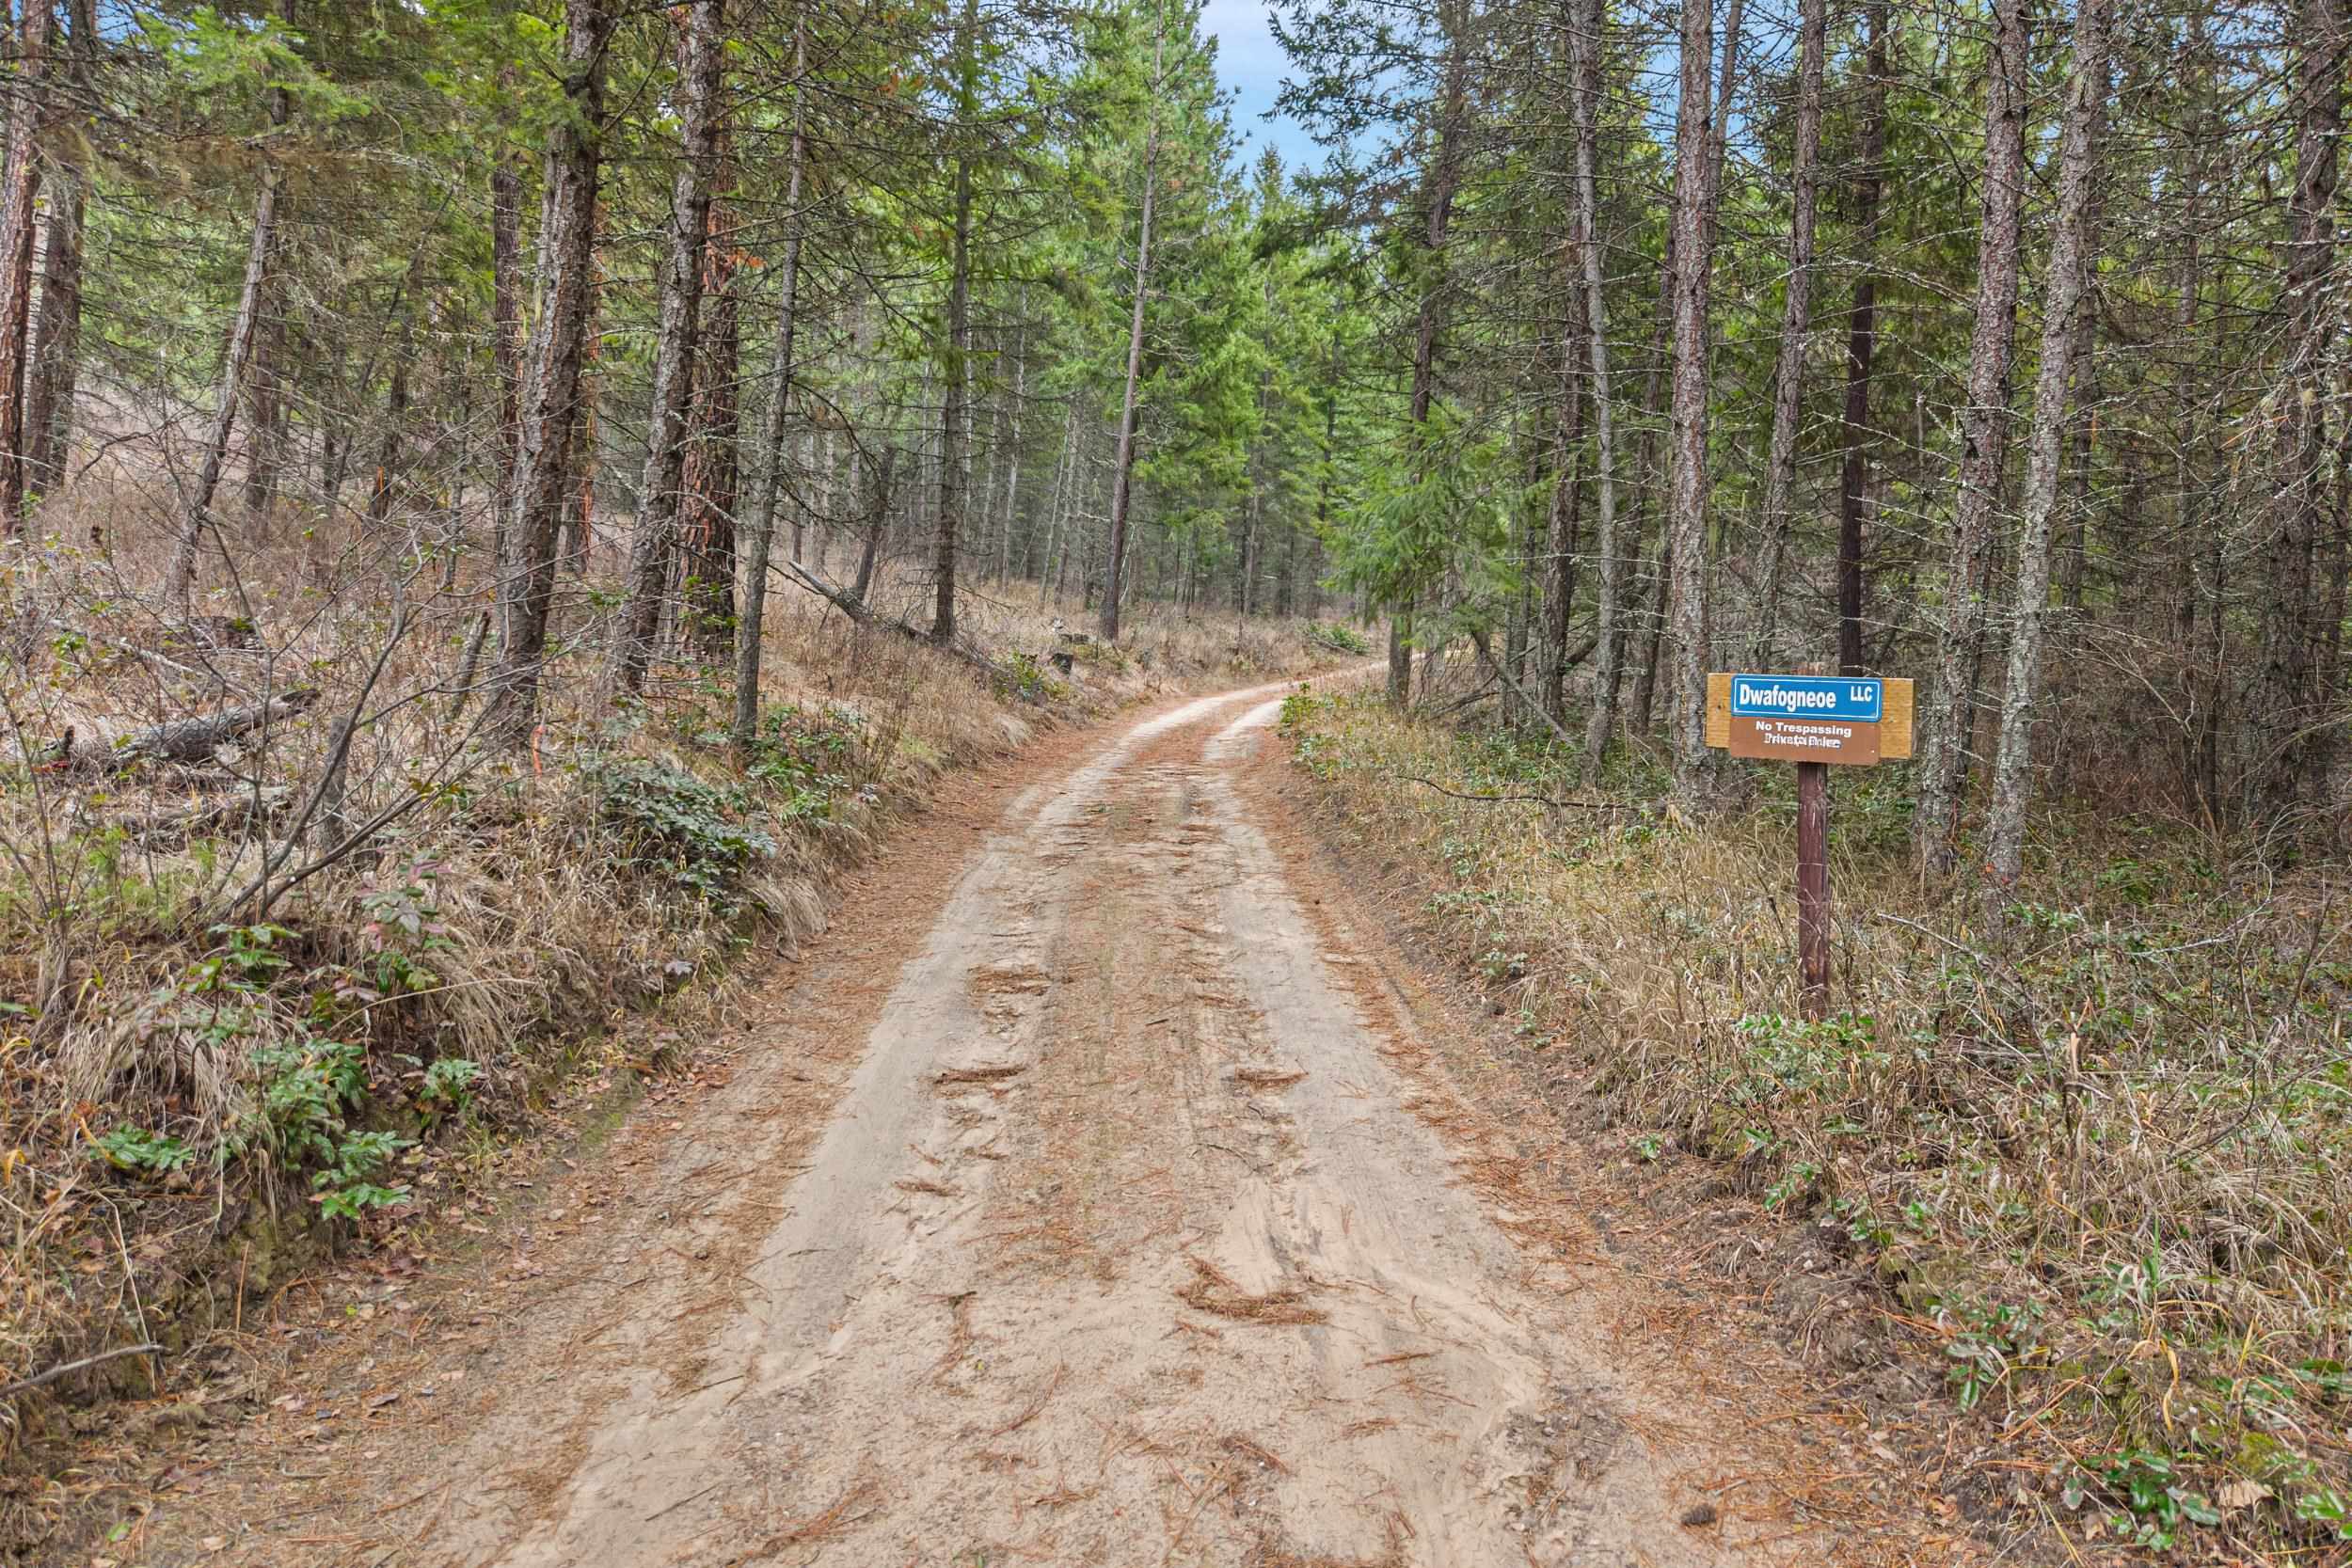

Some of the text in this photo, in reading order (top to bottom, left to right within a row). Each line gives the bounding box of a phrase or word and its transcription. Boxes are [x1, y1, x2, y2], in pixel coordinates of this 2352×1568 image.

[1740, 684, 1873, 712] Dwafogneoe LLC
[1756, 721, 1851, 738] No Trespassing
